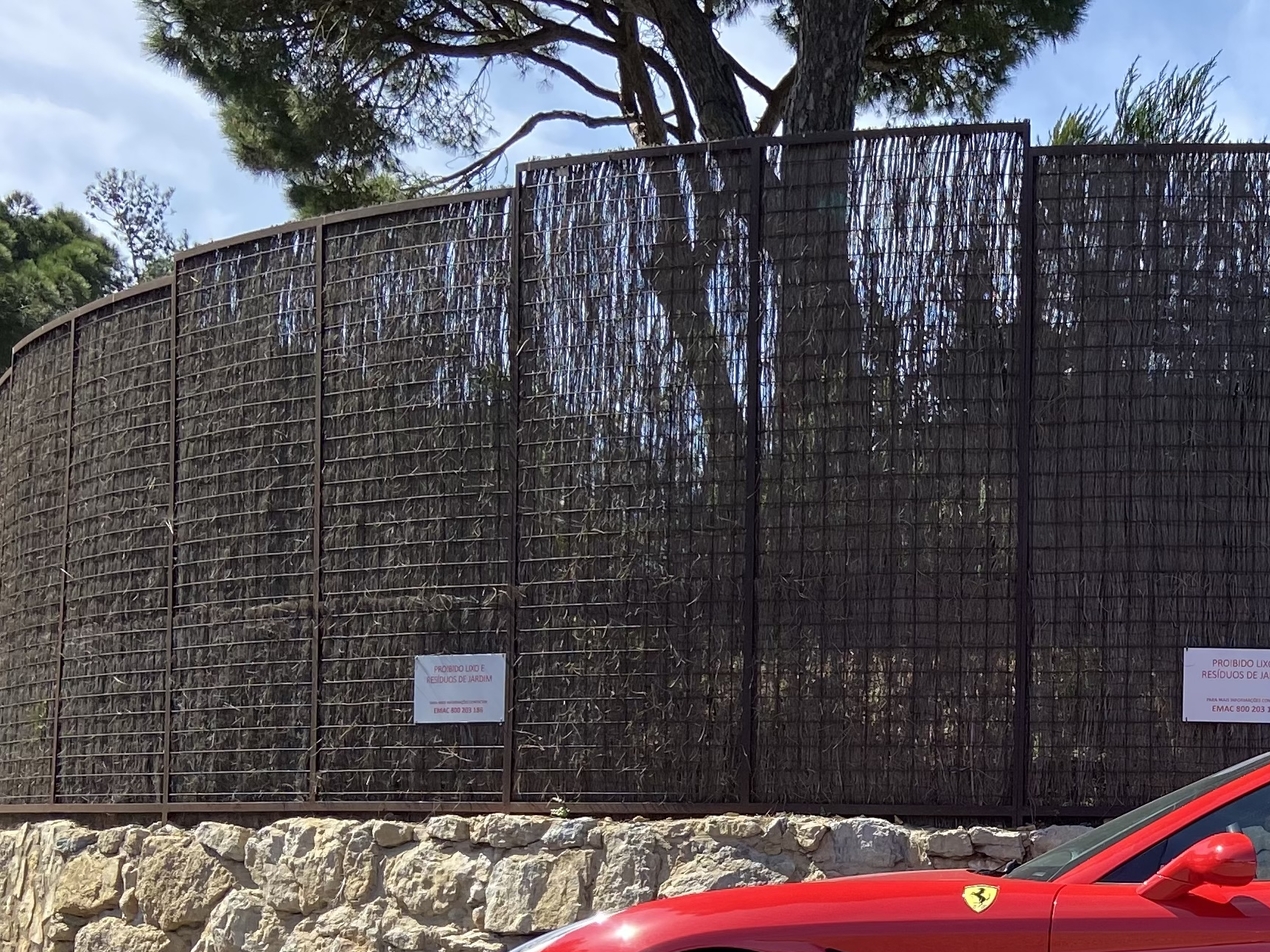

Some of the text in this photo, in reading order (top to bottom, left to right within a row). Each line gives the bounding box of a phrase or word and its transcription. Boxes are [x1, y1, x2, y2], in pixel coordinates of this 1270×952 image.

[1212, 659, 1254, 668] PROIBIDO
[434, 664, 485, 673] PROIBIDO LIXO E
[1201, 668, 1244, 679] RESÍDUOS
[1246, 671, 1257, 680] DE
[427, 674, 492, 684] RESÍDUOS DE JARDIM
[1211, 705, 1234, 713] EMAC
[1236, 705, 1250, 713] 800
[1251, 705, 1265, 713] 203
